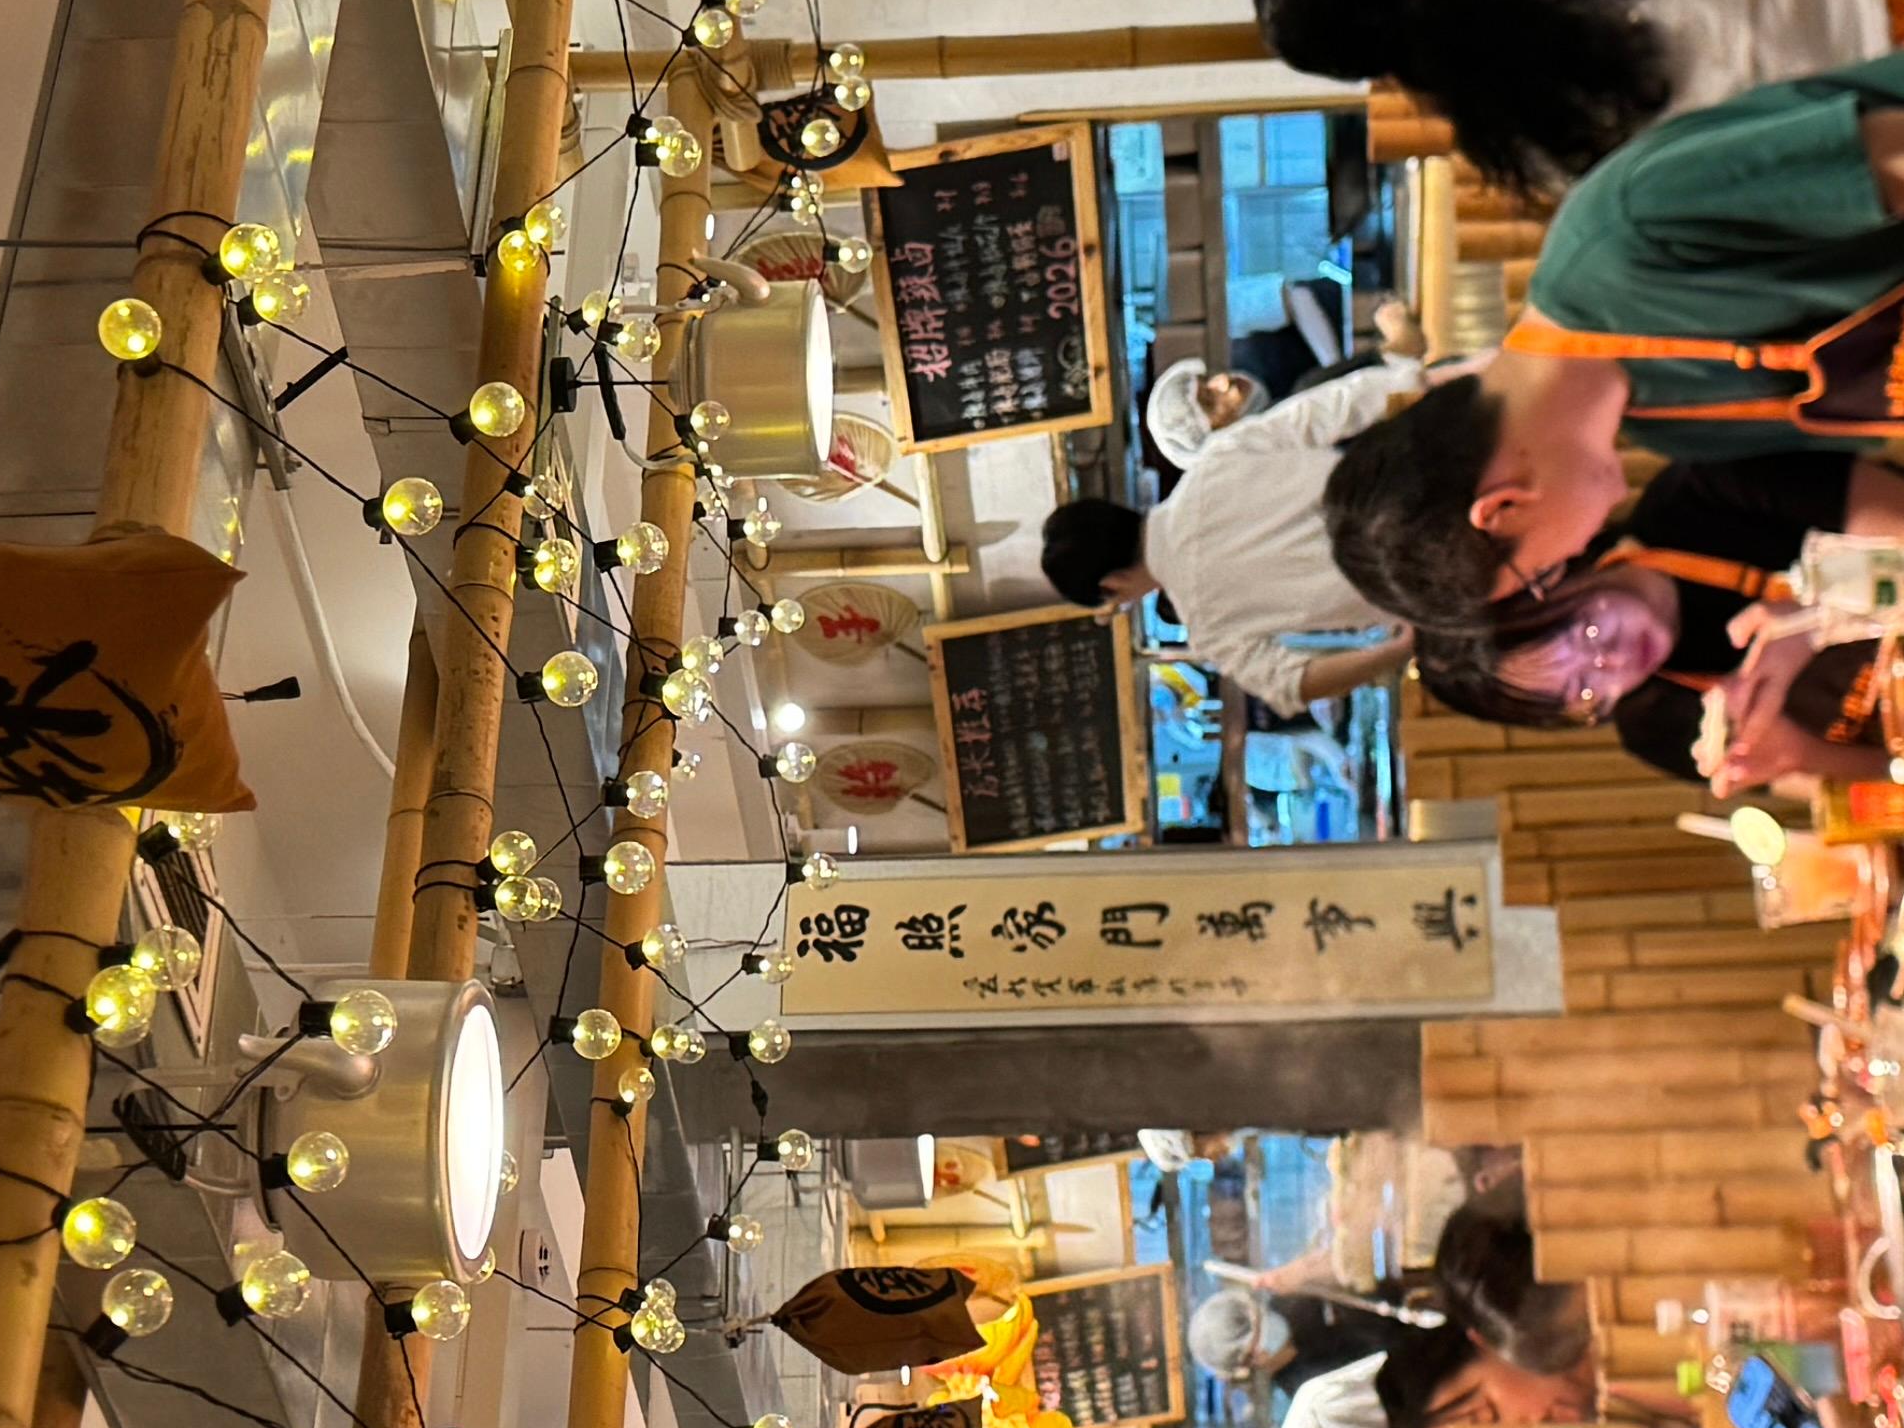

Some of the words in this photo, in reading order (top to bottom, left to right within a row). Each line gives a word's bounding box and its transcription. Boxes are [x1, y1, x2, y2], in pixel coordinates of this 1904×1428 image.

[1040, 235, 1080, 319] 2026
[796, 886, 1481, 963] 福照家門萬事興
